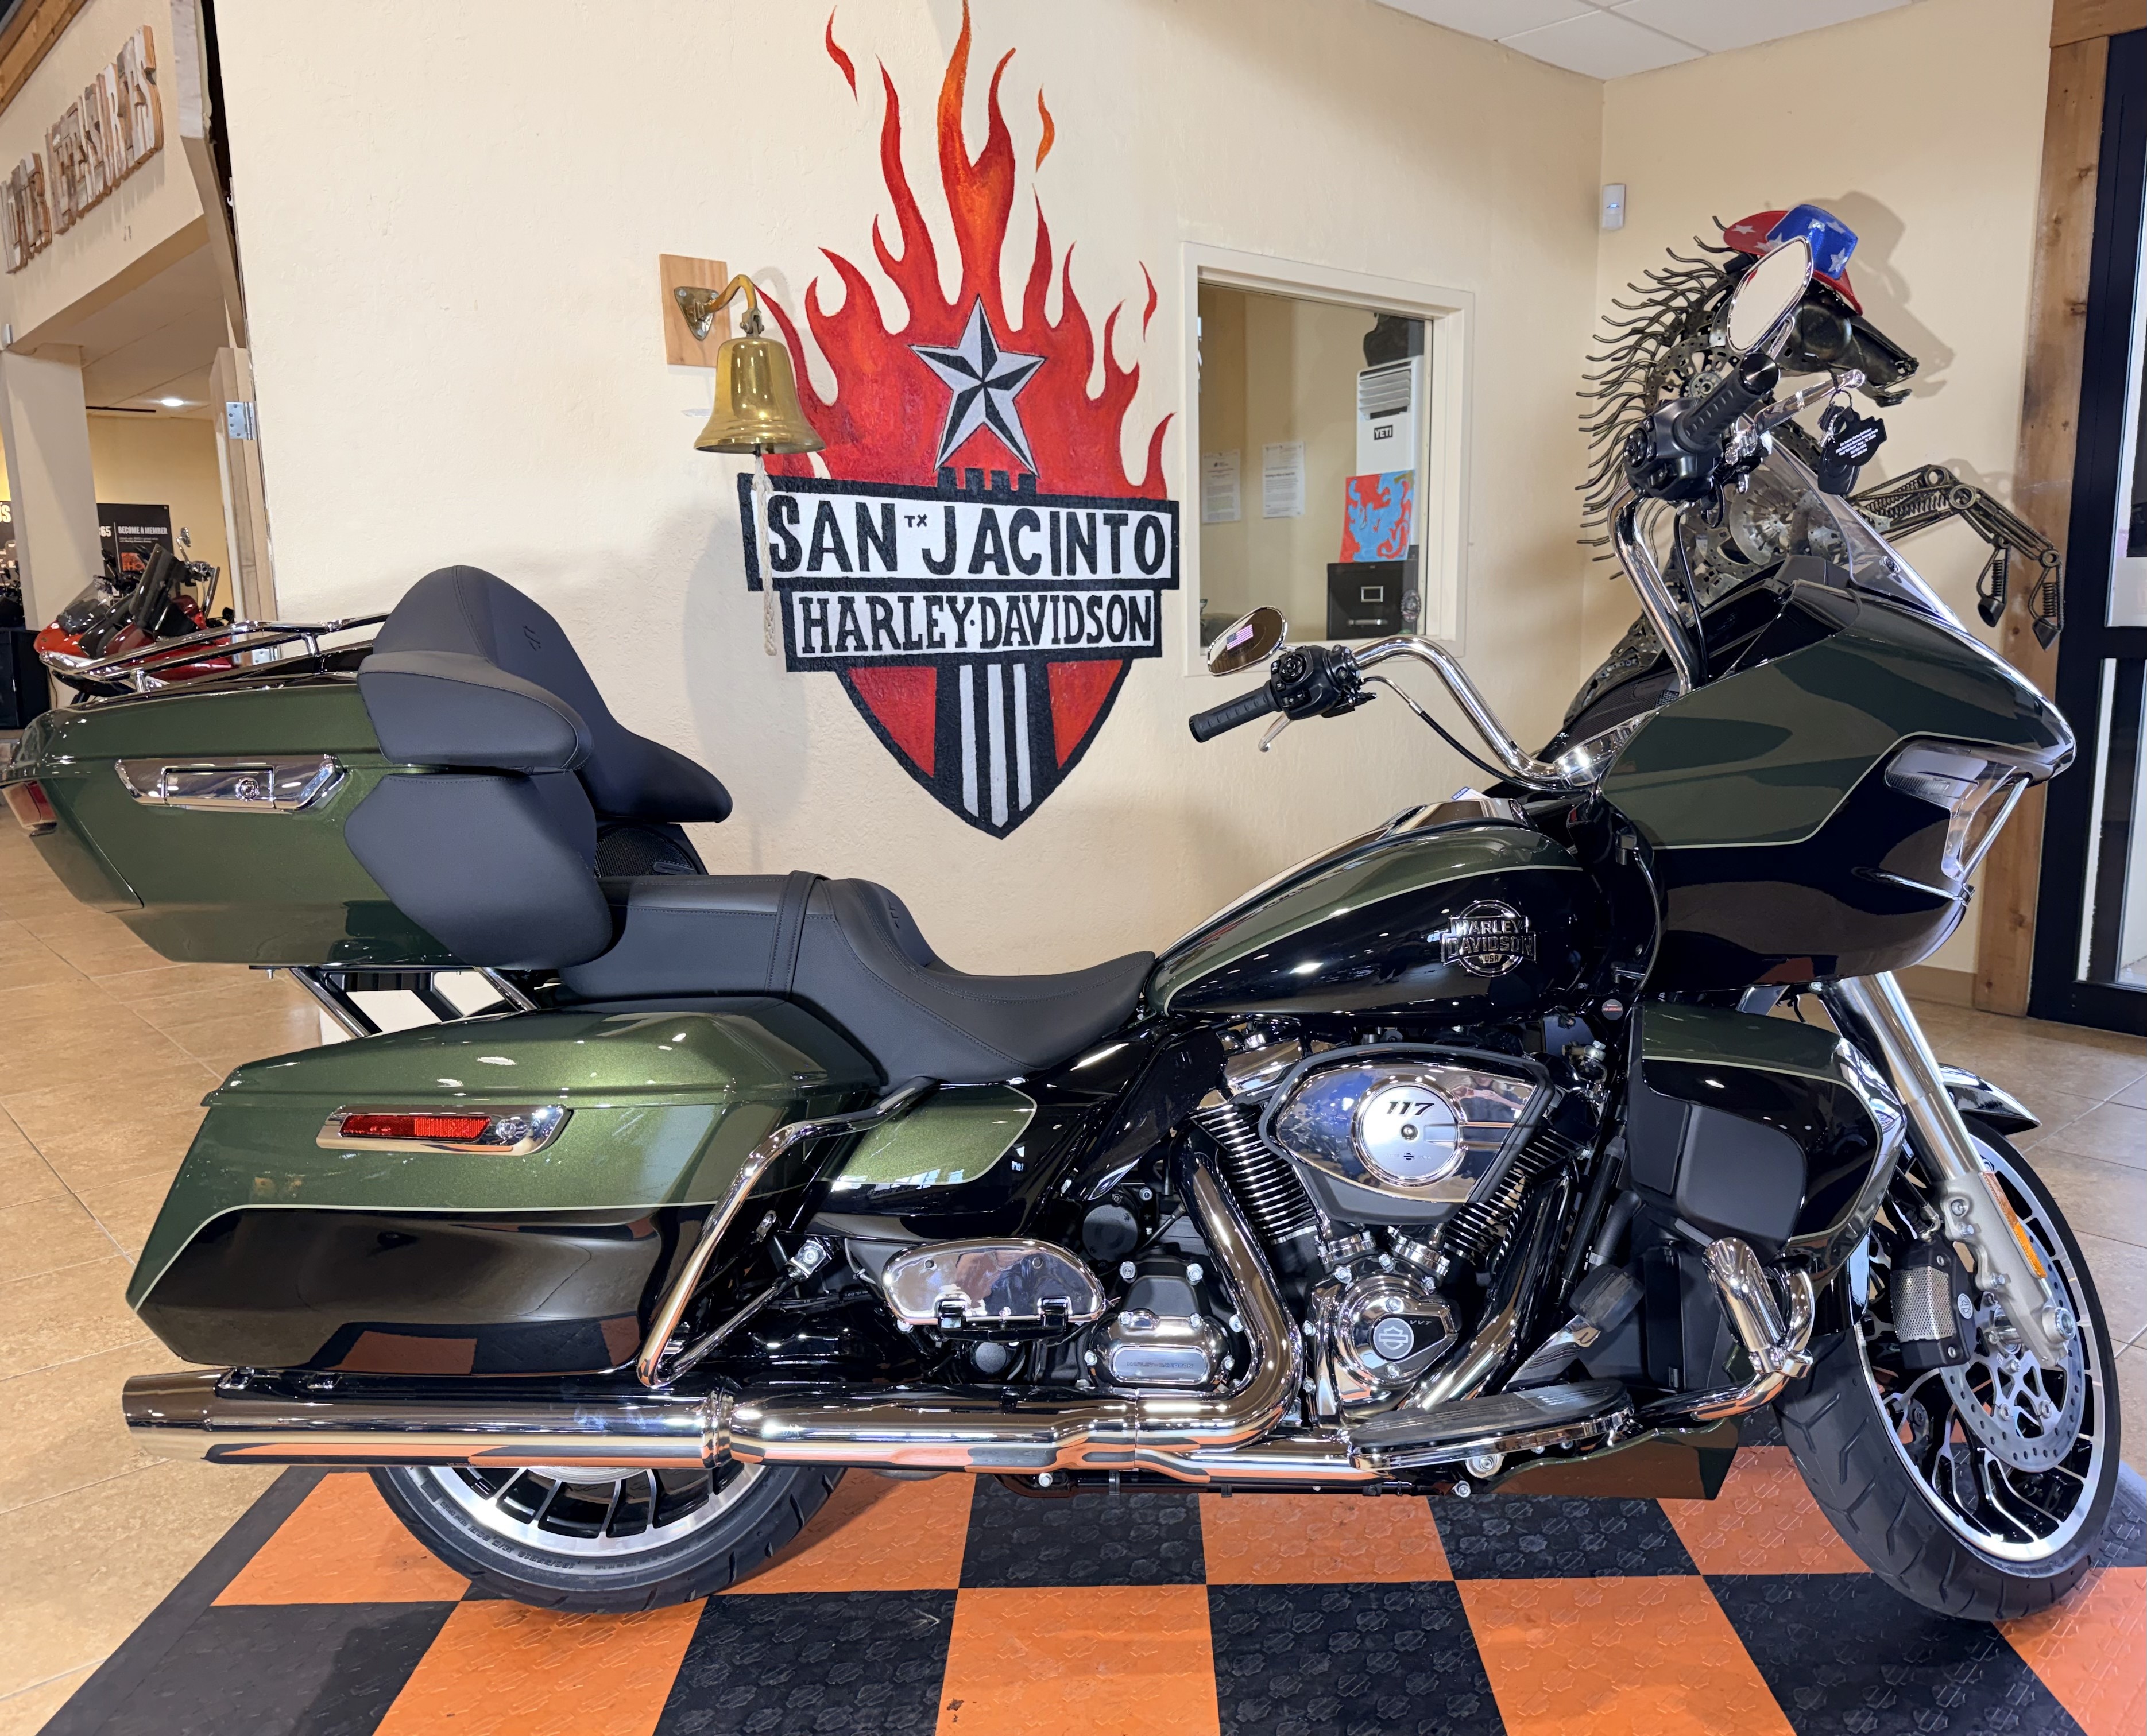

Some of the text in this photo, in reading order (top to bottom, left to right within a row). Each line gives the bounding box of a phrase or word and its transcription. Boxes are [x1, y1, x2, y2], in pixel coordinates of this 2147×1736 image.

[1375, 427, 1392, 439] YETI
[905, 514, 928, 528] TX
[99, 525, 111, 537] 65
[118, 526, 140, 534] BECOME
[145, 526, 168, 534] MEMBER
[768, 494, 897, 572] SAN
[922, 506, 1166, 576] JACINTO
[1455, 920, 1523, 935] HARLEY
[1447, 936, 1533, 959] DAVIDSON
[1484, 955, 1499, 963] USA
[1386, 1101, 1436, 1116] 117
